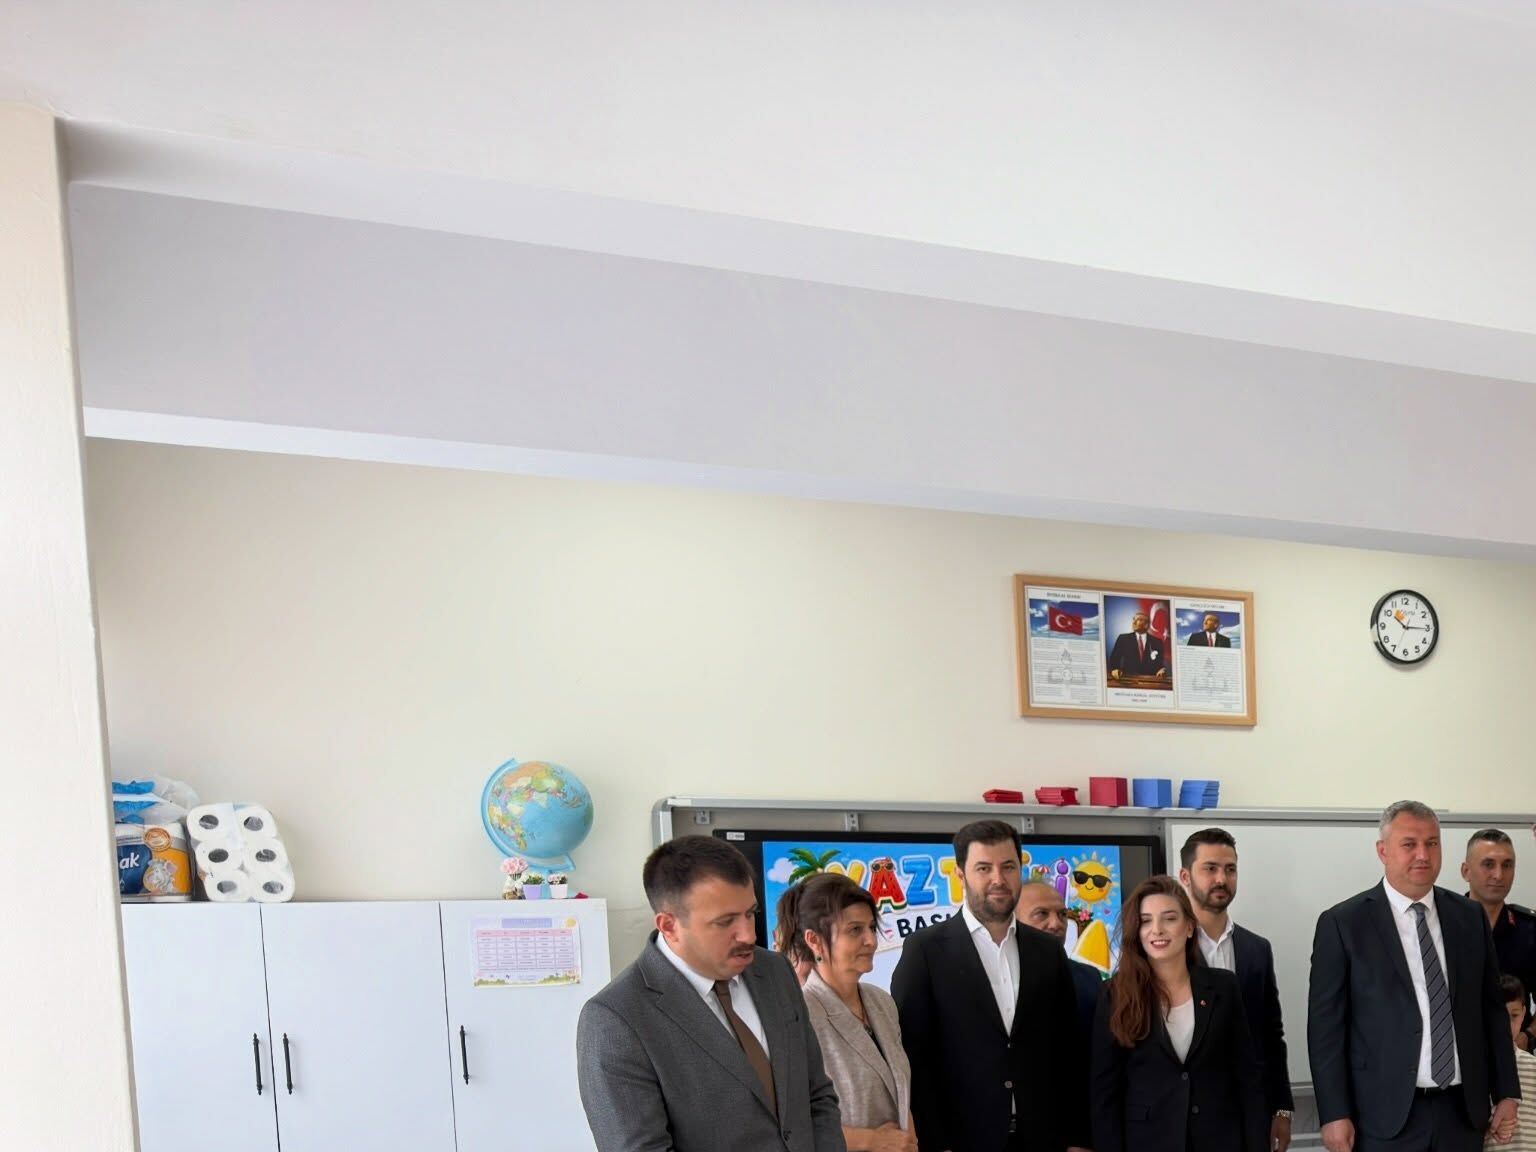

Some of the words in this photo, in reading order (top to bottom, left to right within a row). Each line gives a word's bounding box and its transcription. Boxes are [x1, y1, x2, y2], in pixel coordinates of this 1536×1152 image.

[1384, 609, 1393, 617] 10
[1380, 622, 1386, 630] 9
[1415, 645, 1420, 653] 5
[119, 852, 140, 870] ak
